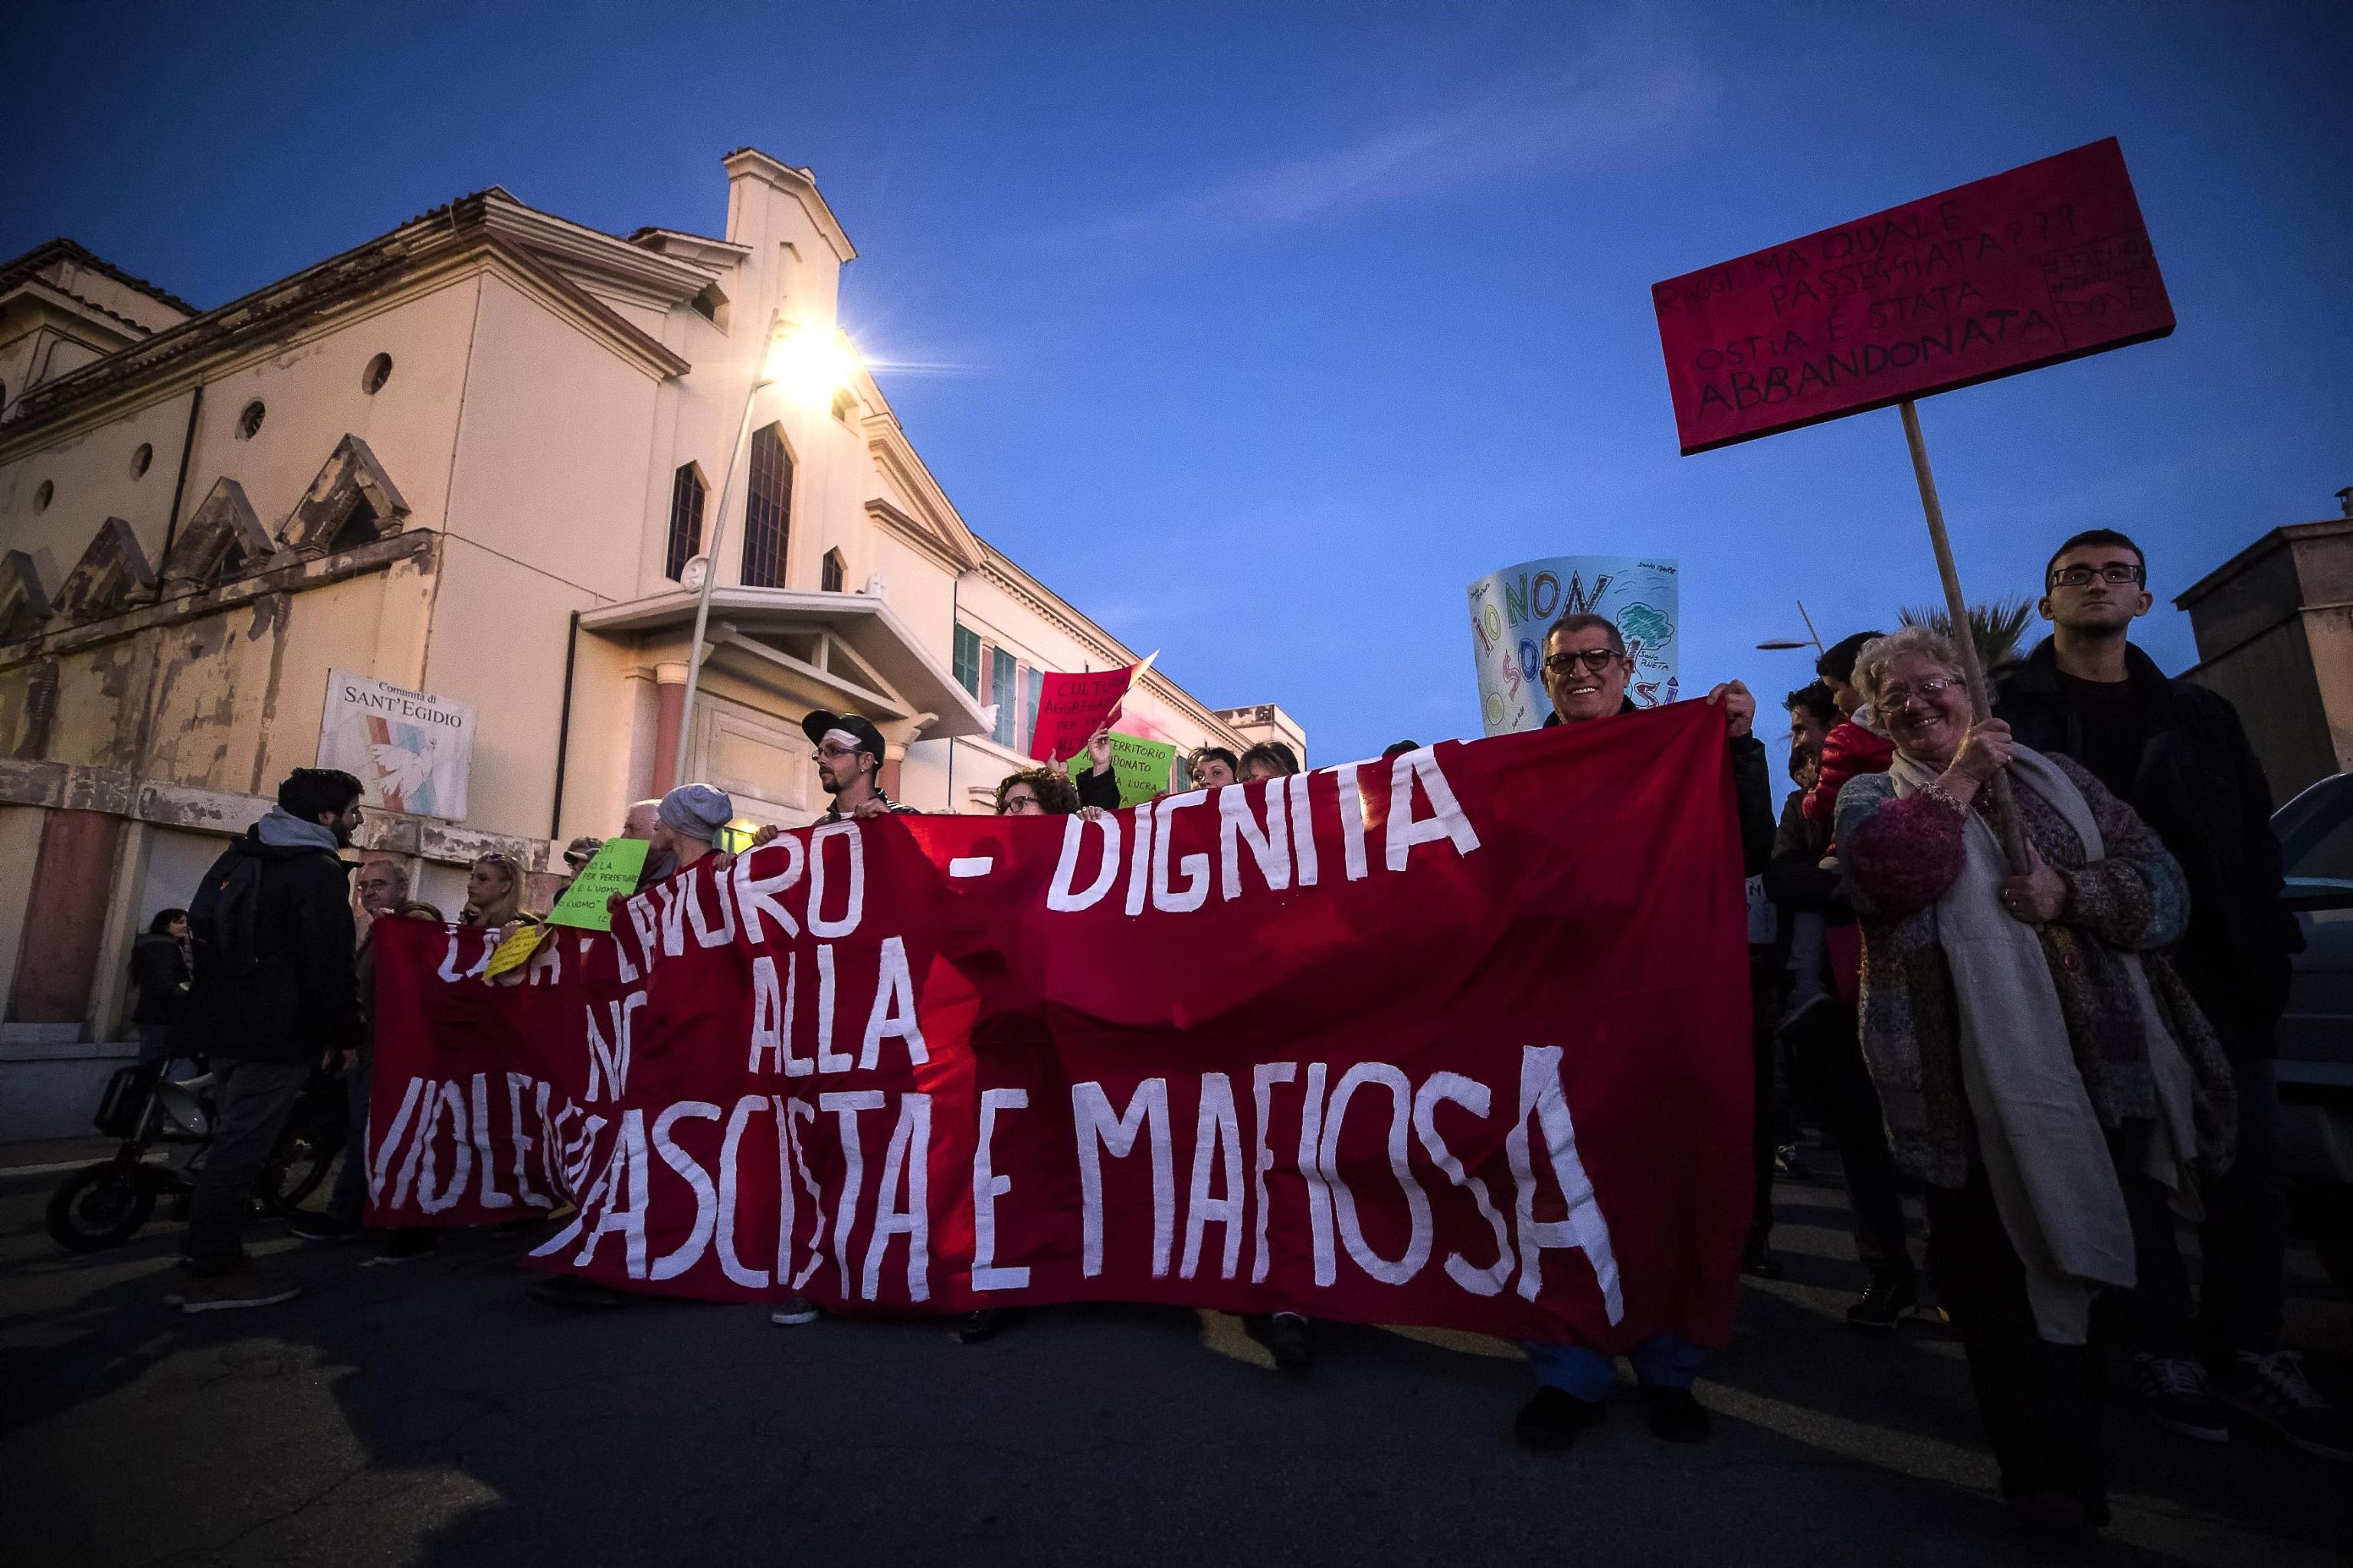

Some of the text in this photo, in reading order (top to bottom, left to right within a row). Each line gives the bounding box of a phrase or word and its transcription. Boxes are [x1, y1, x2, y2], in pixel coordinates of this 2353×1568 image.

[1755, 248, 1811, 283] MA
[1823, 200, 1961, 260] QUALE
[1868, 281, 1985, 329] STATA
[1698, 308, 2054, 421] ABBANDONATA
[345, 686, 462, 728] SANT'EGIDIO
[427, 694, 437, 705] di
[1128, 779, 1157, 792] LUCRA
[600, 862, 612, 870] LA
[748, 935, 930, 1078] ALLA
[971, 1087, 1029, 1291] E
[1072, 1045, 1624, 1327] MAFIOSA
